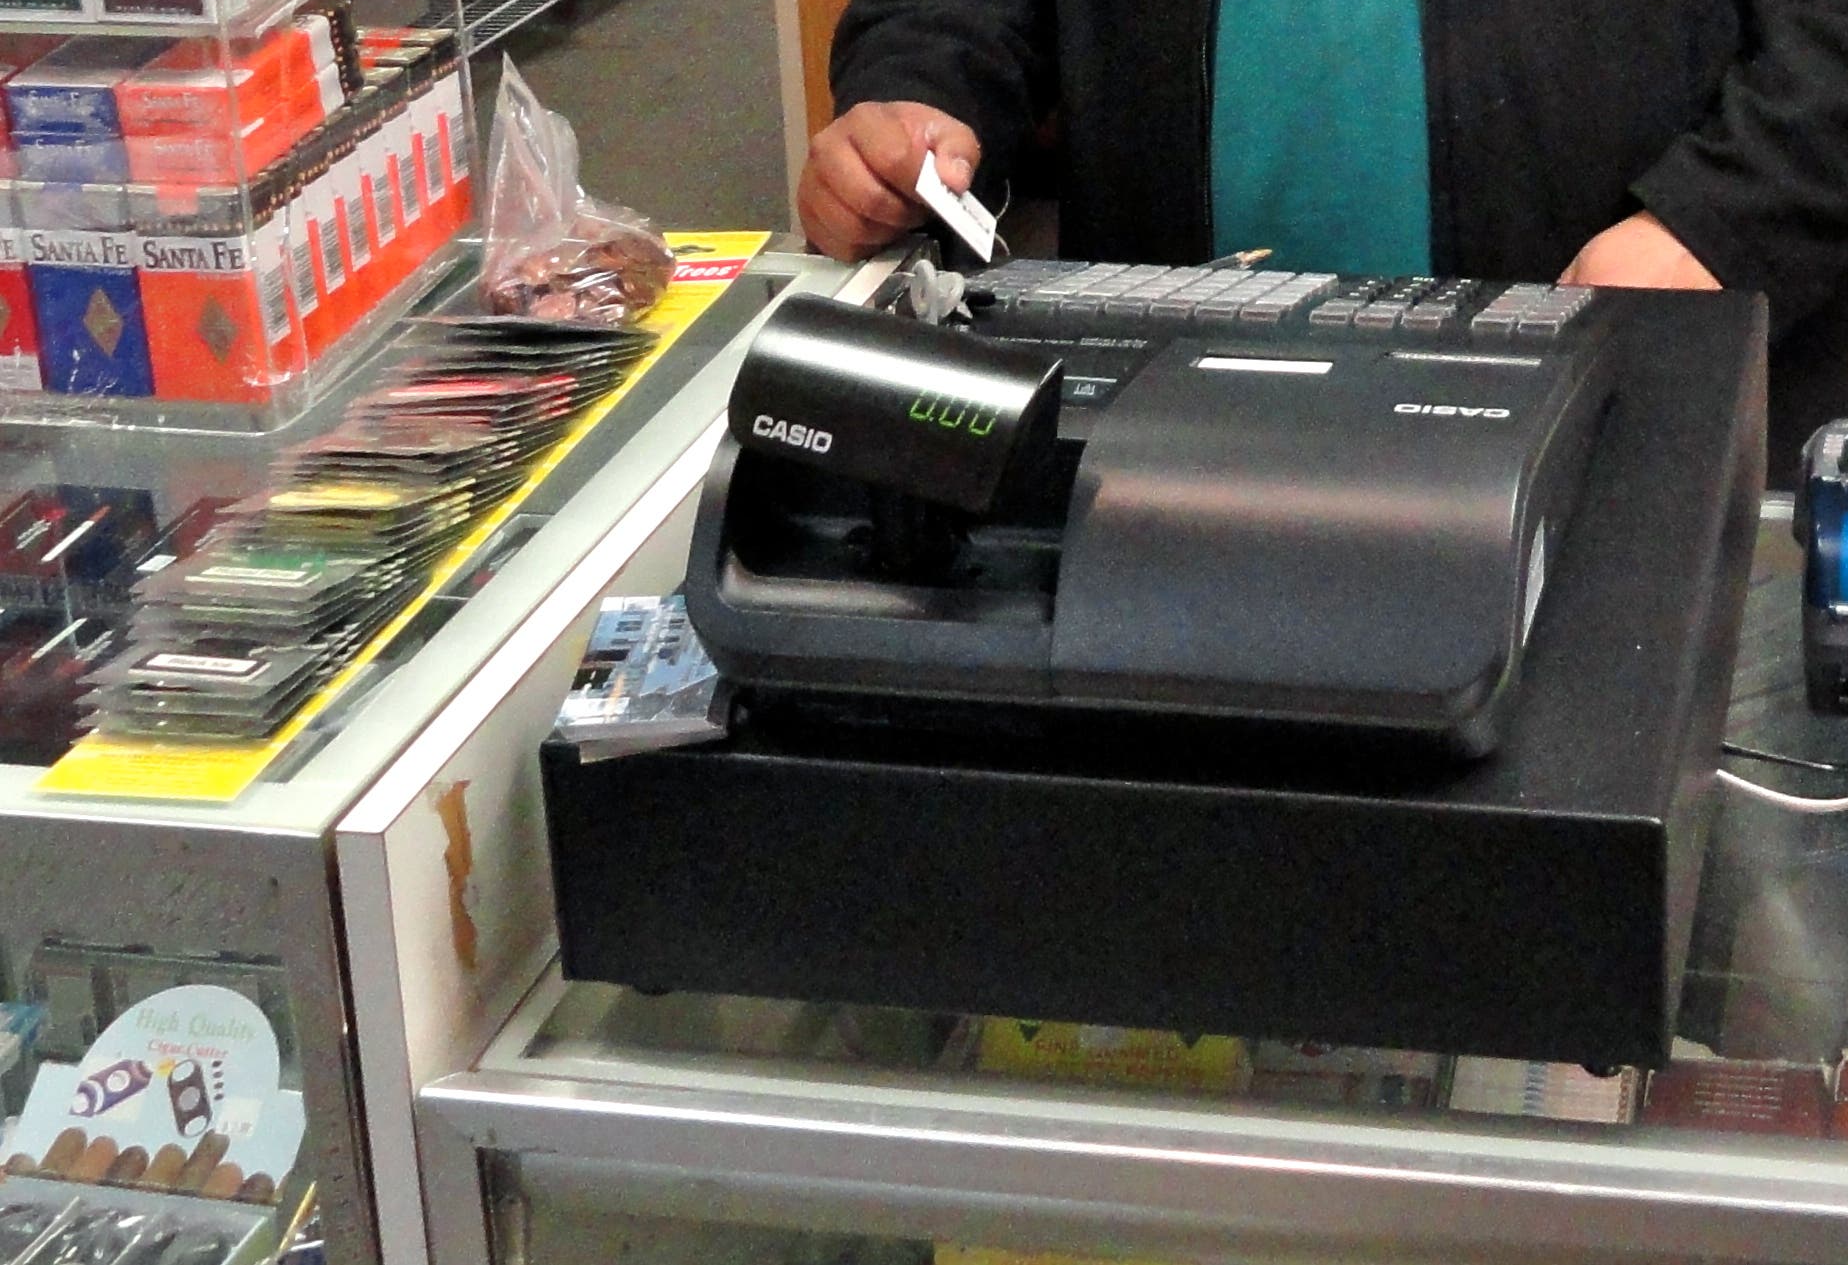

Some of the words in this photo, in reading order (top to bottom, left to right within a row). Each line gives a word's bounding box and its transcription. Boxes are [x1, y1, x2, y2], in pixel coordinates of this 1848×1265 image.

[31, 233, 97, 263] SANTA
[102, 235, 128, 265] FE
[143, 240, 207, 269] SANTA
[211, 240, 245, 270] FE
[675, 264, 733, 278] Trees
[1393, 403, 1510, 418] CASIO
[752, 414, 833, 455] CASIO
